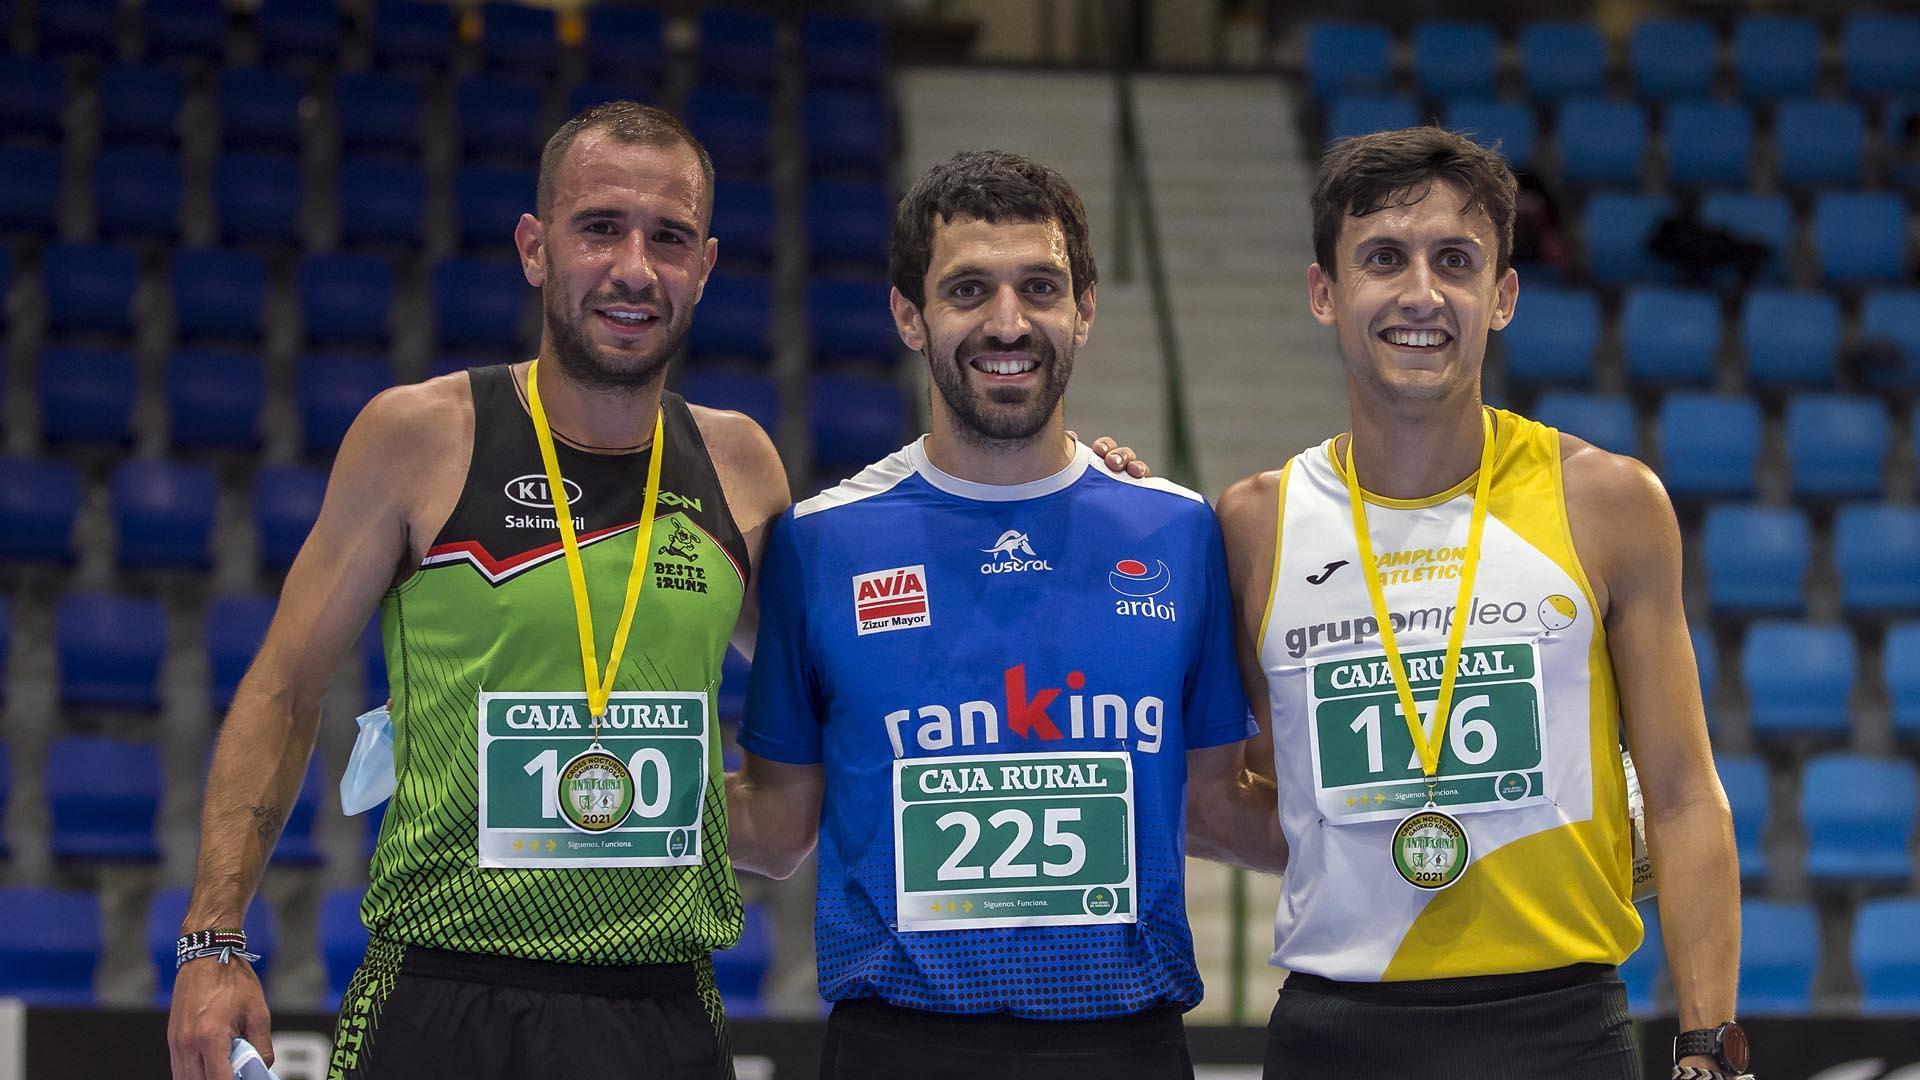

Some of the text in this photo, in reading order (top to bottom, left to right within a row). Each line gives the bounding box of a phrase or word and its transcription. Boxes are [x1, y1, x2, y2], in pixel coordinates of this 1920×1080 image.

[518, 482, 570, 500] KI
[1374, 547, 1480, 568] AMPLON
[654, 562, 706, 579] BESTE
[1115, 597, 1176, 622] ardoi
[862, 615, 926, 631] Zizur Mayor
[1331, 651, 1515, 690] CAJA RURAL
[505, 705, 582, 730] CAJA
[884, 662, 1164, 760] ranking
[566, 757, 626, 780] CROSS NOCTURNO
[919, 763, 1108, 794] CAJA RURAL
[523, 747, 672, 819] 10
[583, 814, 611, 824] 2021
[1401, 816, 1460, 838] CROSS NOCTURNO
[935, 808, 1087, 881] 225
[1415, 872, 1443, 882] 2021
